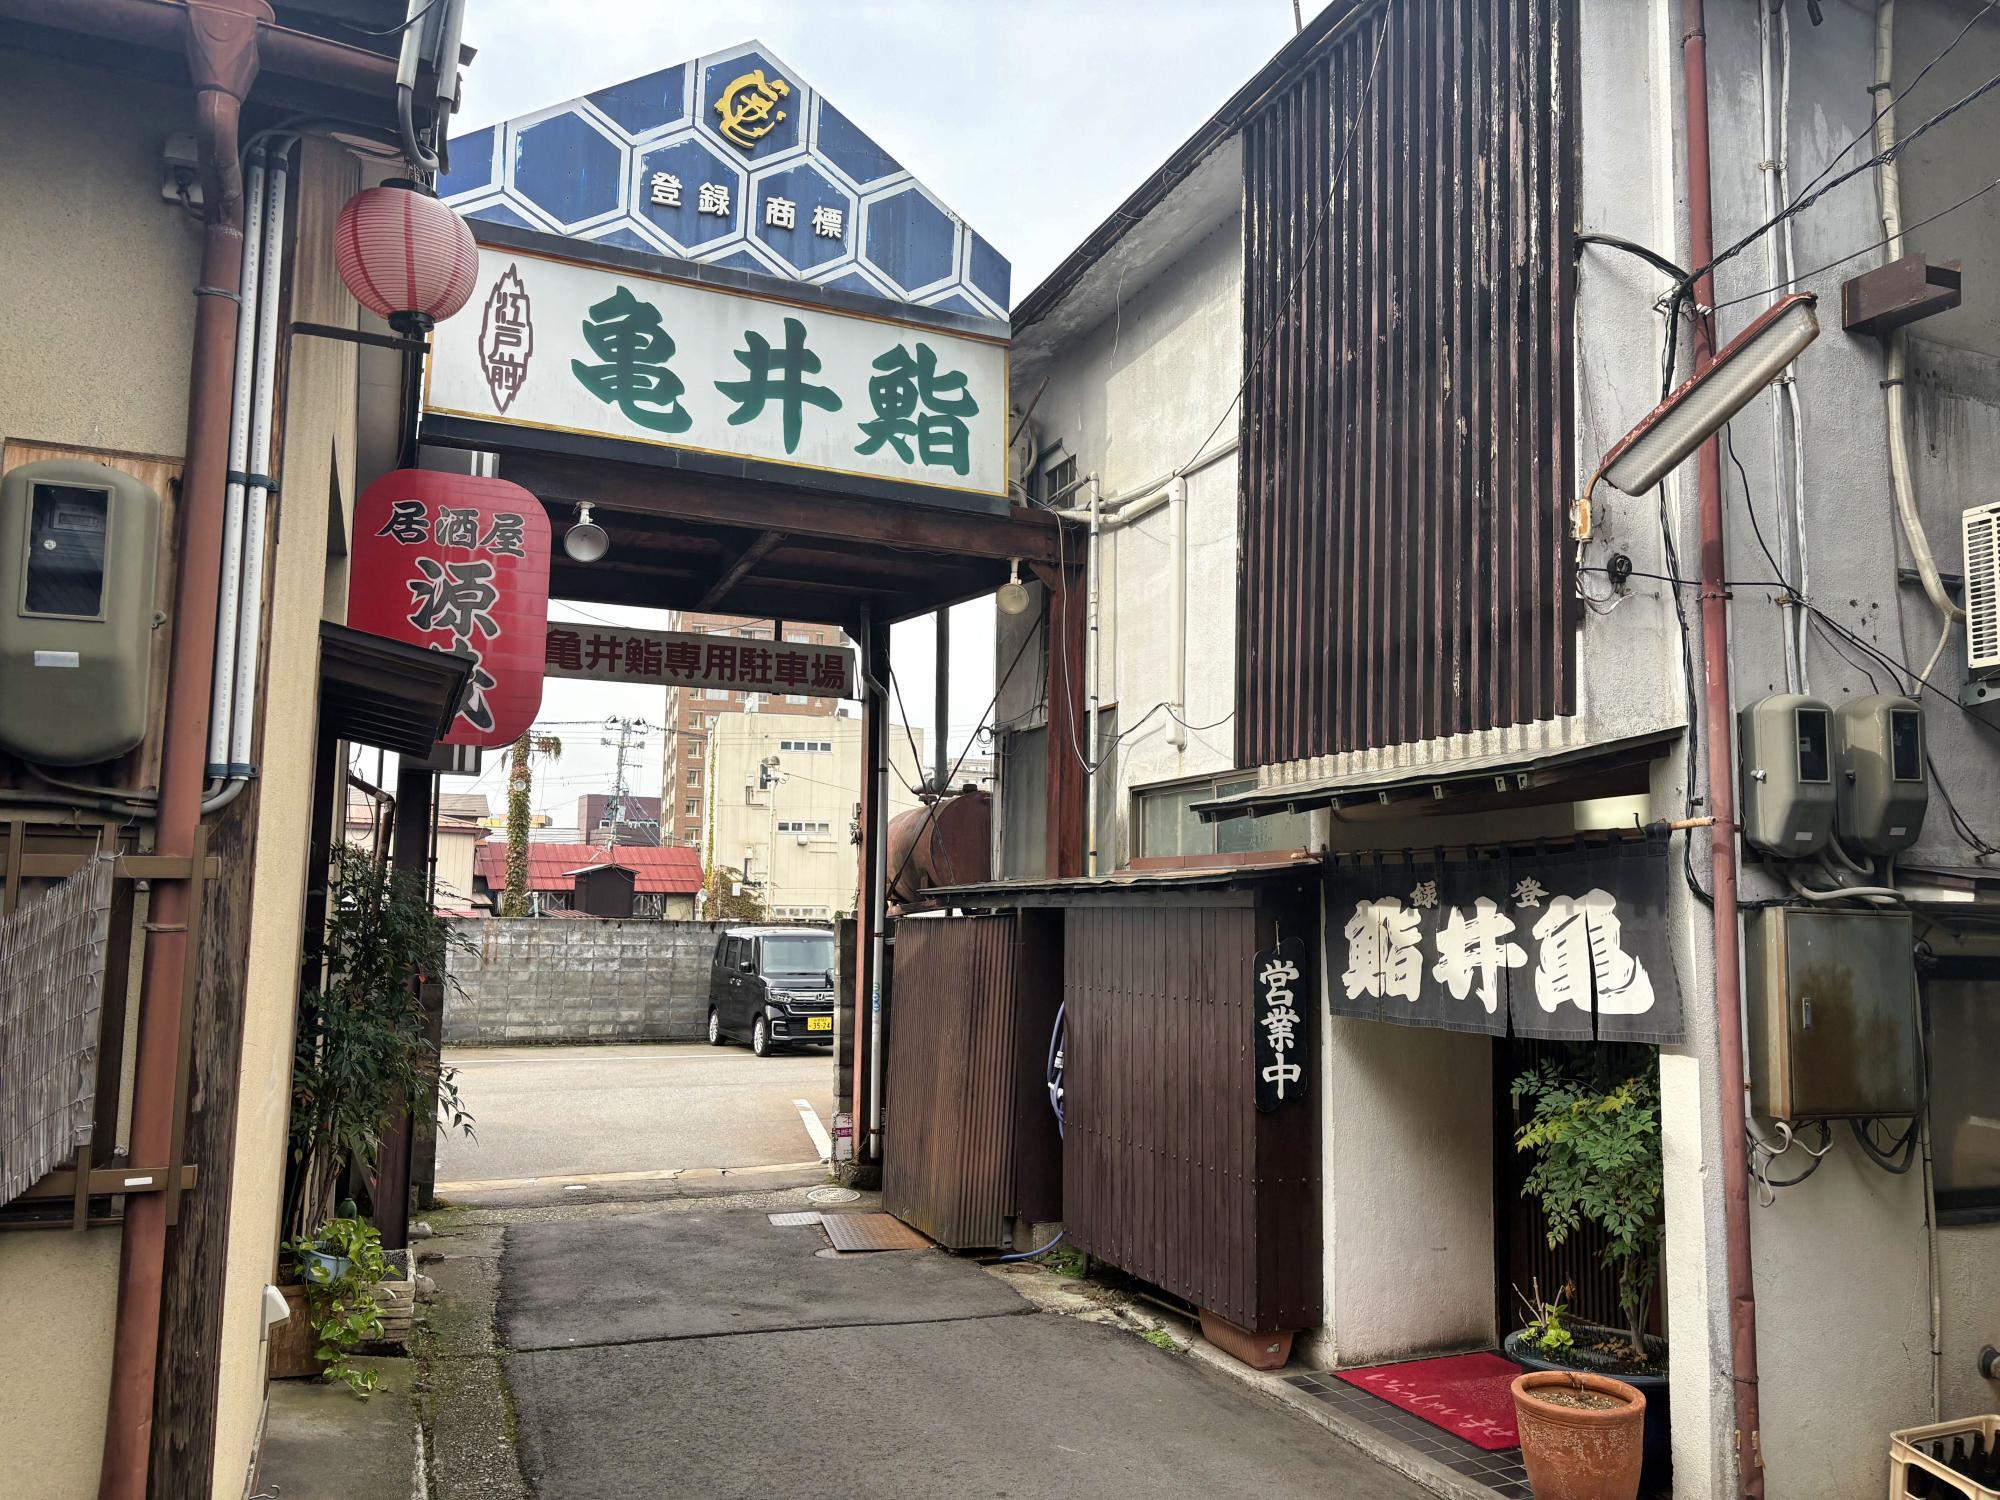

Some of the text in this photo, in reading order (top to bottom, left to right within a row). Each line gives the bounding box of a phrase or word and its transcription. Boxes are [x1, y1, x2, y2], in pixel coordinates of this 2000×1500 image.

[650, 171, 843, 240] 登録商標
[488, 291, 528, 398] 江戸前
[571, 285, 980, 476] 亀井鮨
[375, 500, 527, 559] 居酒屋
[545, 628, 846, 690] 亀井鮨専用駐車場
[1259, 959, 1302, 1100] 営業中
[1364, 1373, 1516, 1439] いらっしゃいませ
